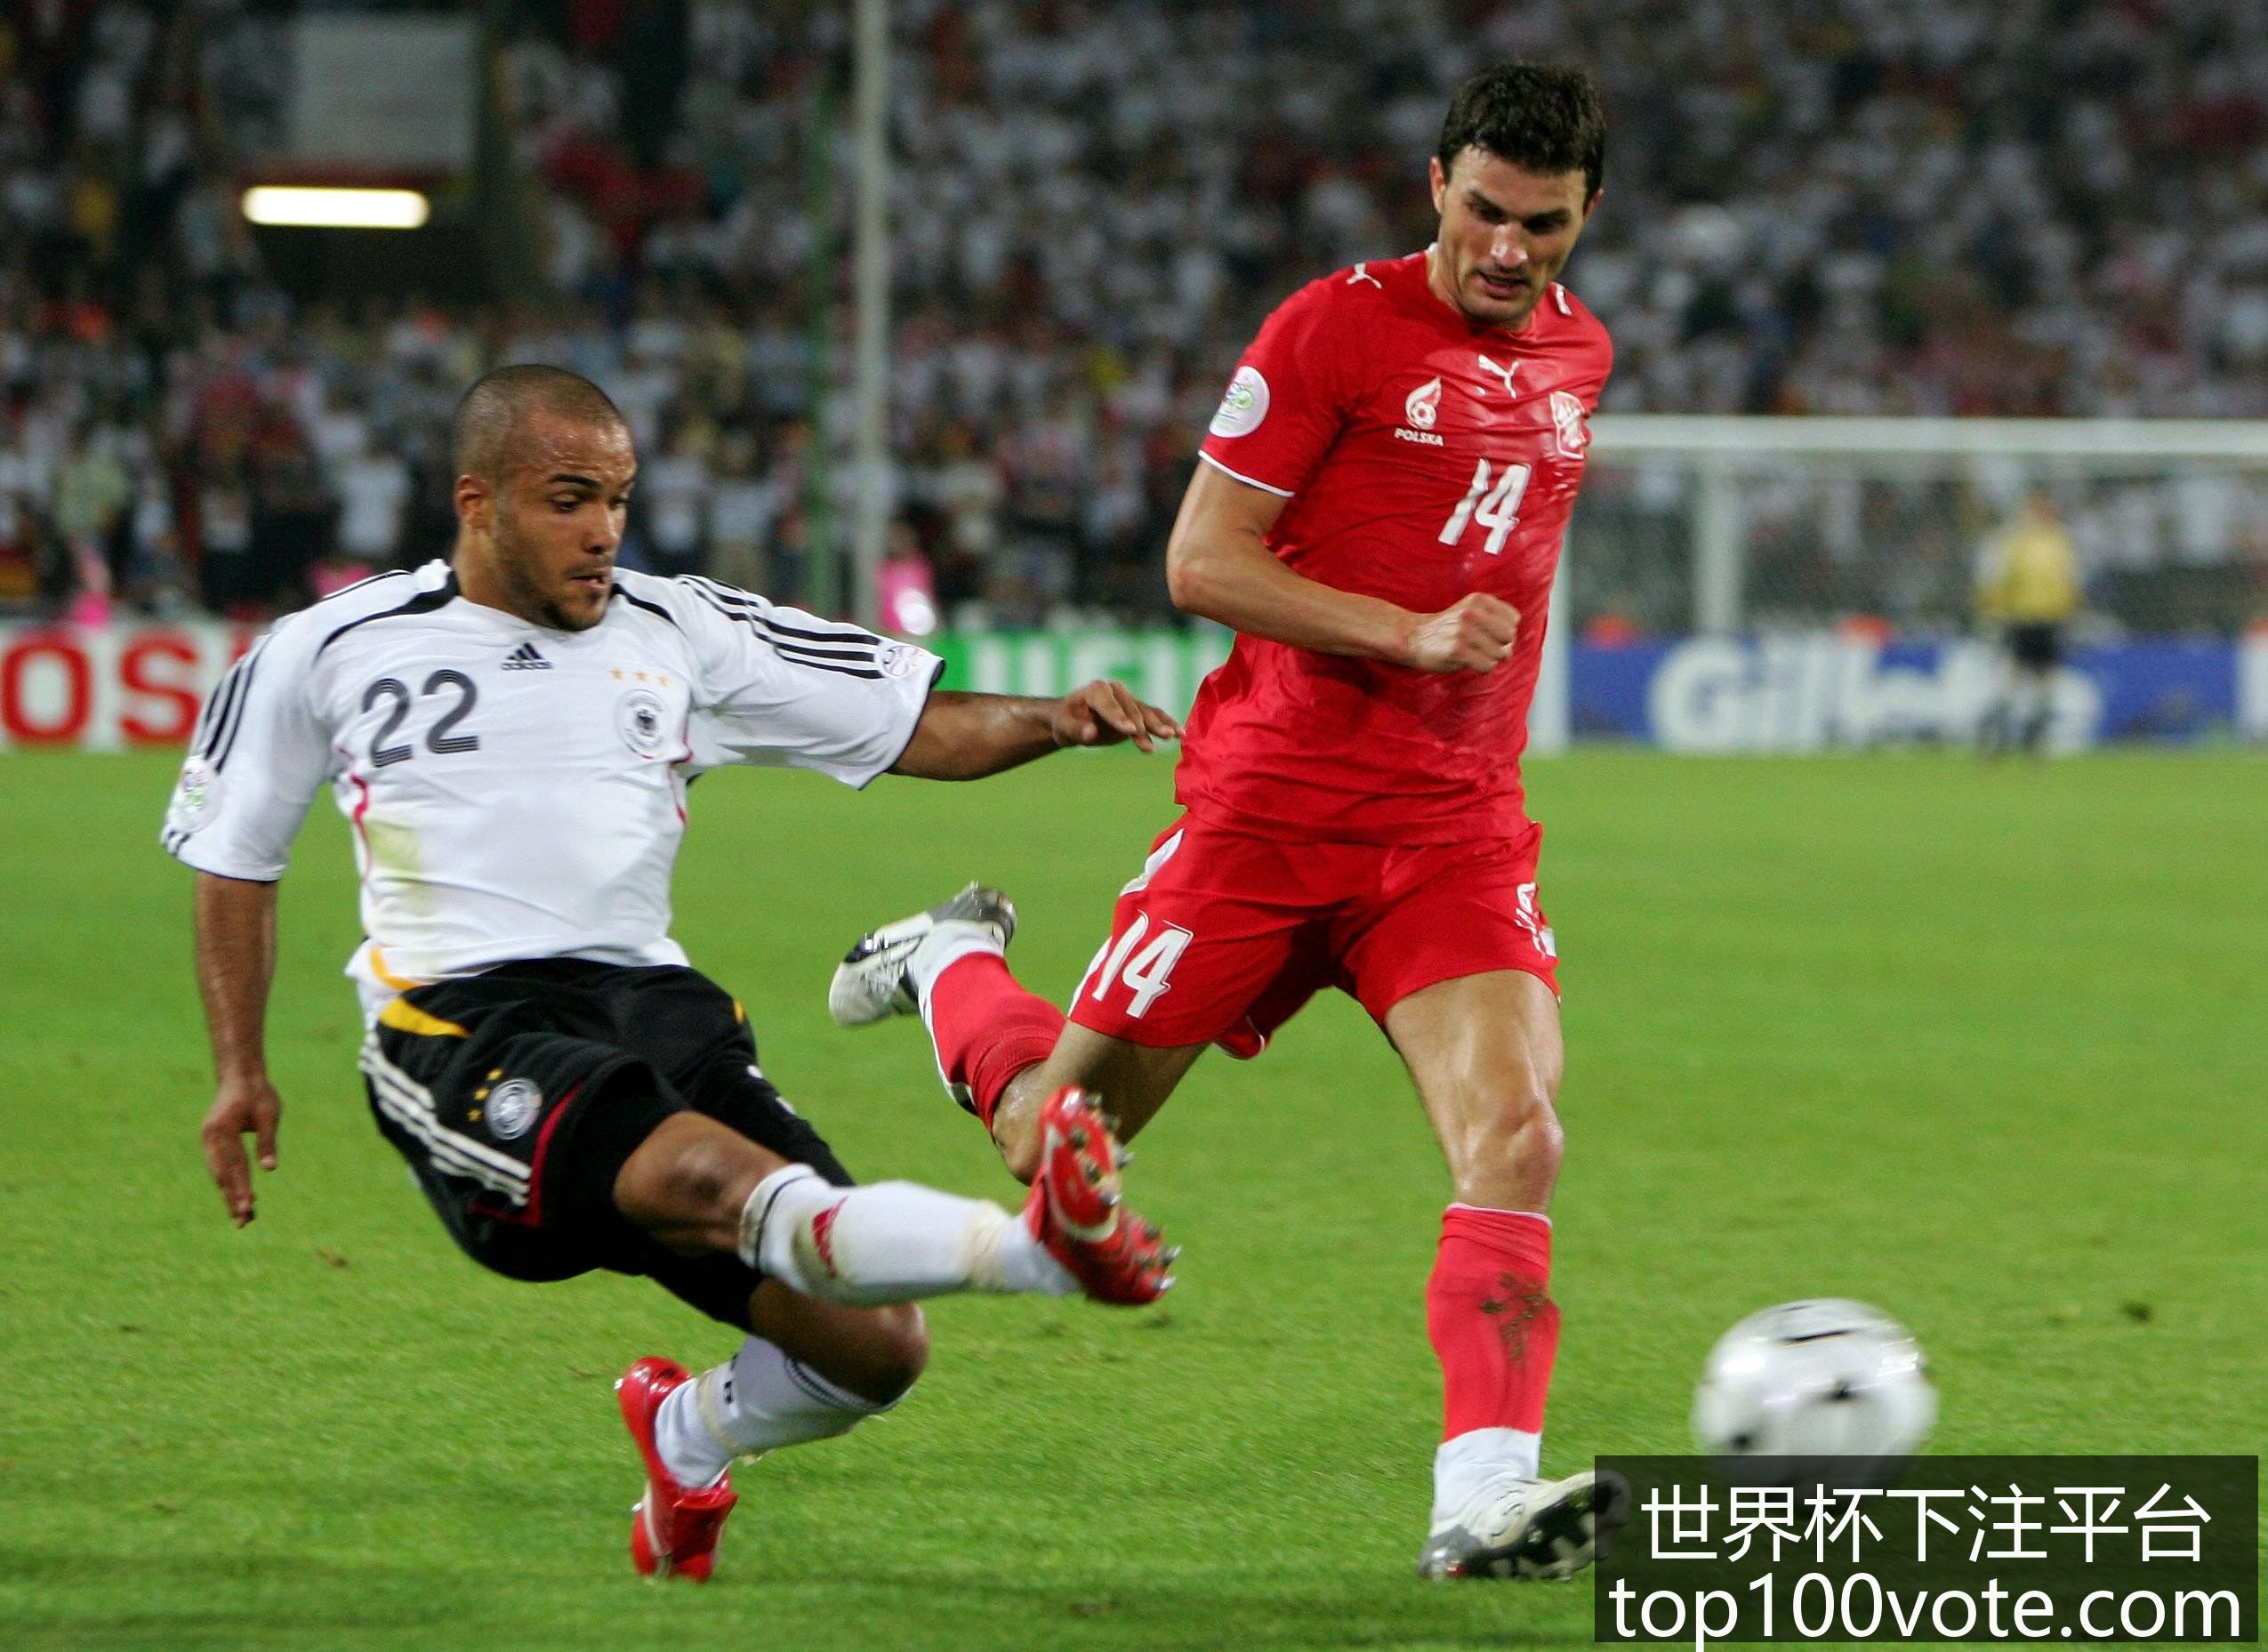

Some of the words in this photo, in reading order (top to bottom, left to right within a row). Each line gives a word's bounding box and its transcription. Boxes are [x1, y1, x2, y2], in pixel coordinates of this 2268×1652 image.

[1395, 427, 1444, 447] POLSKA
[1438, 457, 1532, 555] 14
[0, 630, 245, 745] OS
[361, 669, 480, 767] 22
[1091, 909, 1194, 1019] 14
